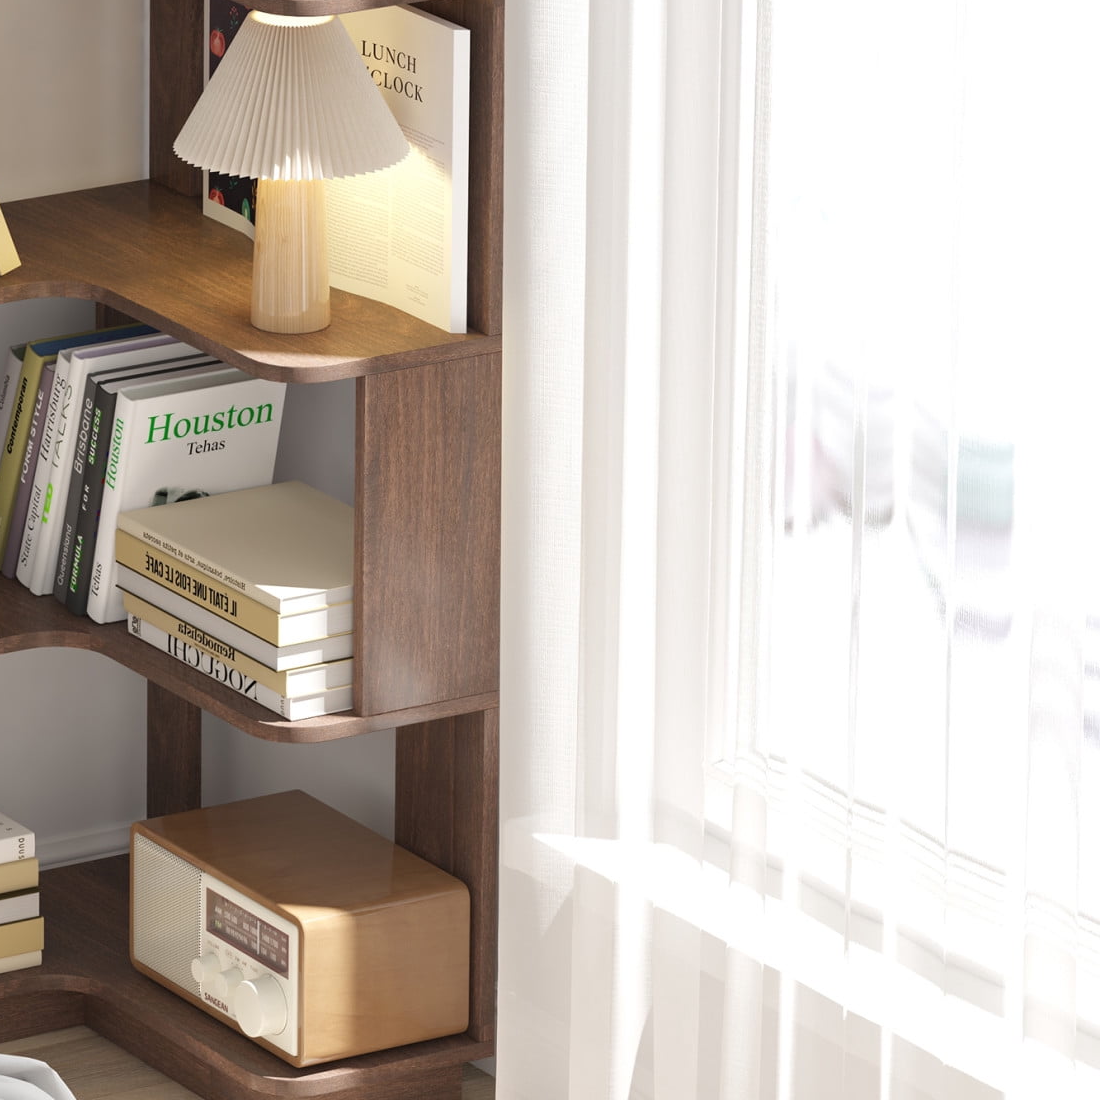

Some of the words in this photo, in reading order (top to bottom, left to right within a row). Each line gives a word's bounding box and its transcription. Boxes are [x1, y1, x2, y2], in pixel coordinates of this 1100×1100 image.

[362, 40, 416, 74] LUNCH
[21, 441, 34, 484] FORM
[30, 390, 44, 437] STYLE
[40, 372, 66, 461] Harrisburg
[74, 398, 93, 474] Brisbane
[144, 402, 273, 444] Houston
[187, 440, 226, 456] Tehas
[42, 483, 53, 524] TED
[52, 384, 72, 468] TALKS
[105, 418, 124, 490] Houston
[21, 534, 32, 567] State
[28, 485, 42, 530] Capital
[70, 536, 83, 593] FORMULA
[82, 484, 90, 511] FOR
[88, 408, 101, 465] SUCCESS
[58, 524, 72, 586] Queensland
[92, 563, 102, 596] Tehas
